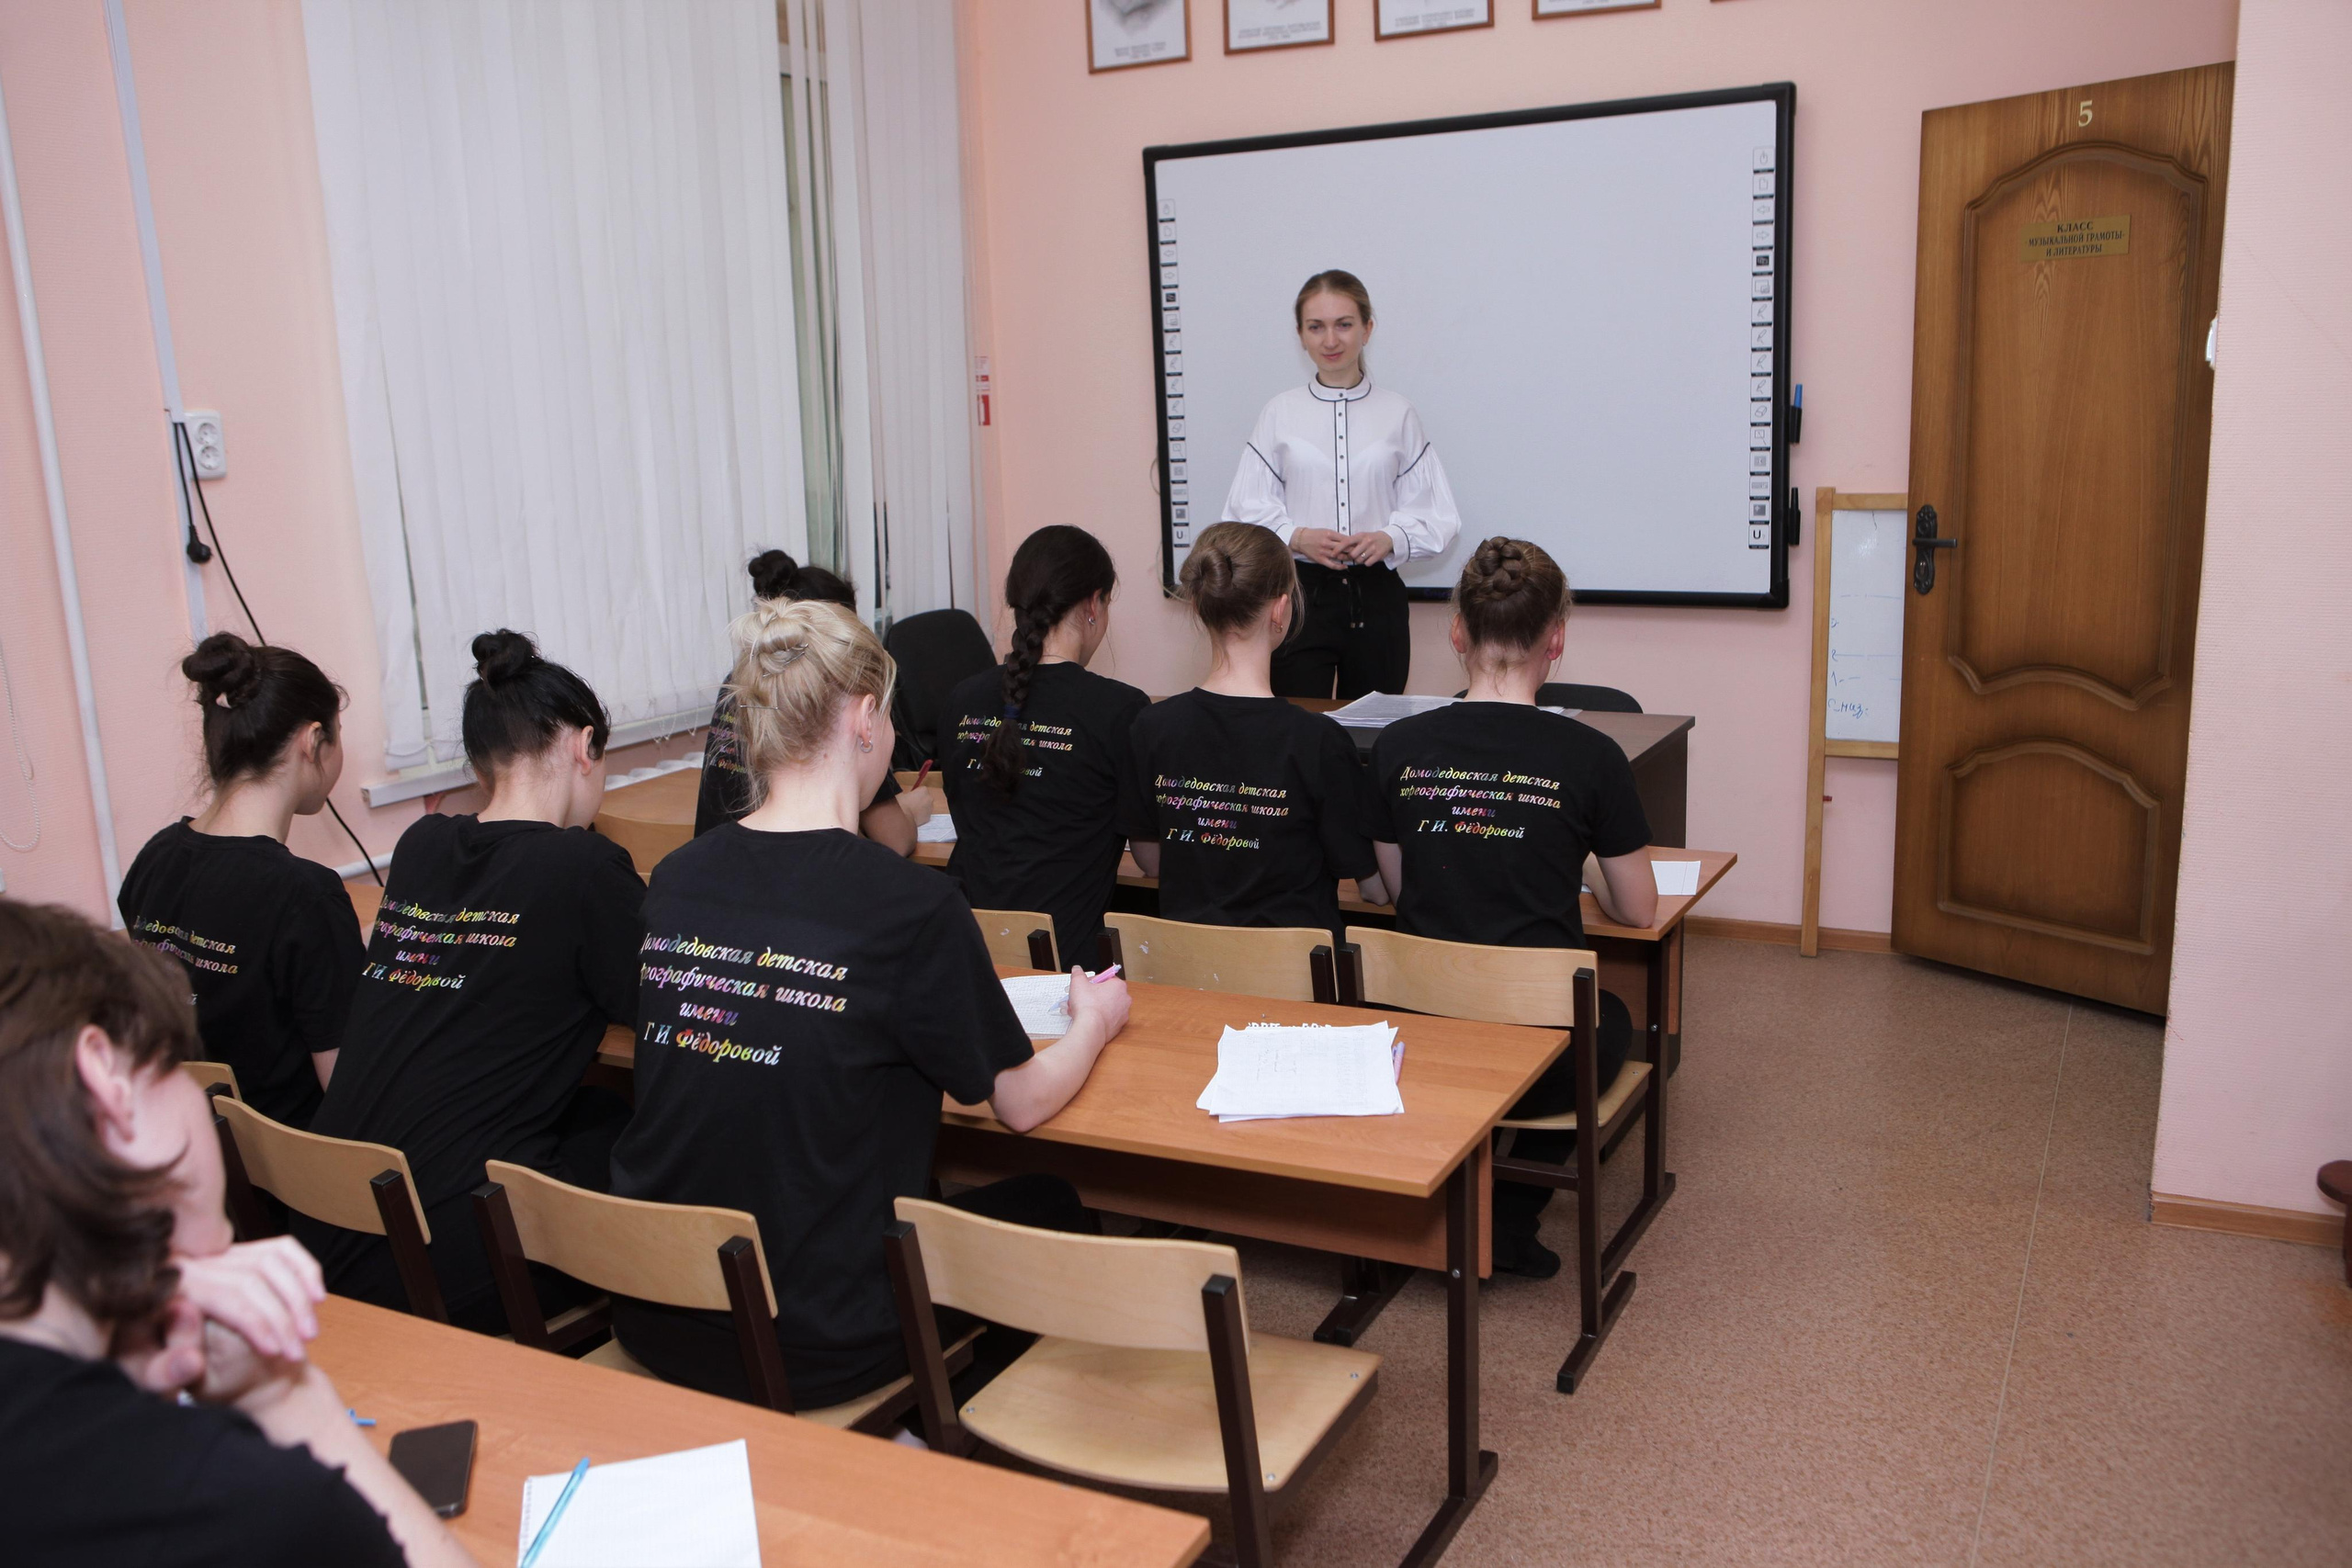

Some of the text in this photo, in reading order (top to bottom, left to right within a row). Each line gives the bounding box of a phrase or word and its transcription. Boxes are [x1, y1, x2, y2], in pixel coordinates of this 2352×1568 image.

[2078, 99, 2093, 128] 5
[2057, 221, 2094, 233] КЛАСС
[2029, 231, 2122, 247] МУЗЫКАЛЬНОЙ ГРАМОТЫ
[2046, 244, 2102, 257] И ЛИТЕРАТУРЫ
[1029, 720, 1072, 736] детская
[1038, 739, 1073, 751] школа
[1399, 766, 1561, 791] Домодедовская детская
[1238, 782, 1286, 799] детская
[1399, 784, 1561, 809] хореографическая школа
[1250, 805, 1289, 817] школа
[1452, 806, 1497, 818] имени
[1197, 817, 1238, 829] имени
[1454, 820, 1526, 840] Фёдоровой
[1201, 832, 1261, 851] Фёдоровой
[455, 908, 521, 925] детская
[466, 933, 517, 948] школа
[756, 946, 849, 981] детская
[775, 986, 848, 1012] школа
[680, 1001, 739, 1026] имени
[675, 1028, 783, 1066] Фёдоровой
